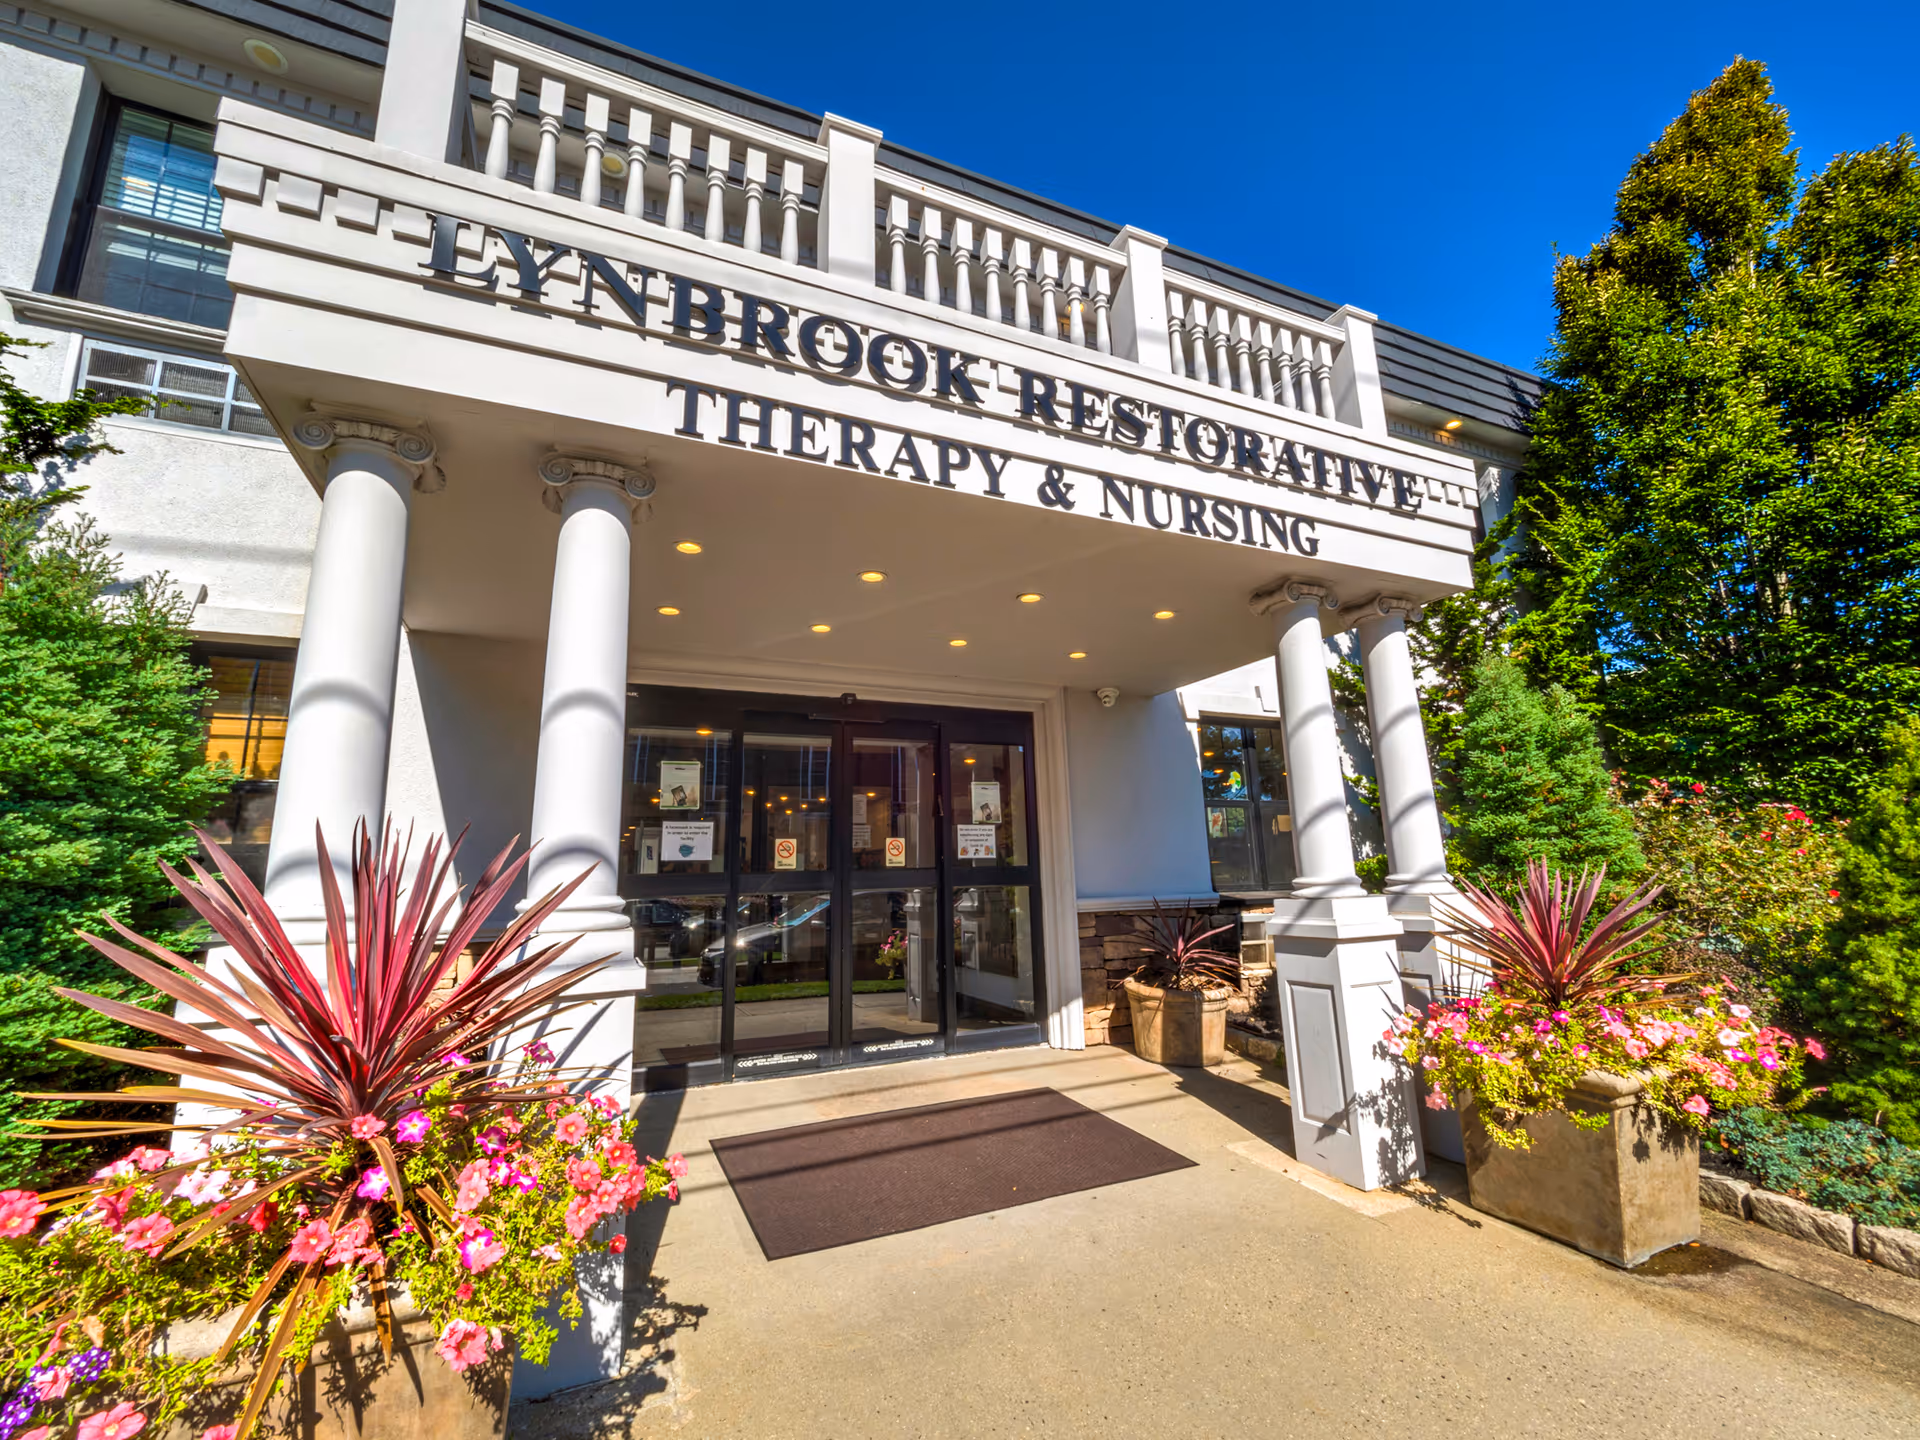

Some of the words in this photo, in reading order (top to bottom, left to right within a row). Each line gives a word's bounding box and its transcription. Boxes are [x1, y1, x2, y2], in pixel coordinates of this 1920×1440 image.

[418, 212, 984, 403] LYNBROOK
[1014, 368, 1424, 513] RESTORATIVE
[666, 380, 1011, 498] THERAPY
[1037, 463, 1076, 510] &
[1099, 475, 1320, 557] NURSING
